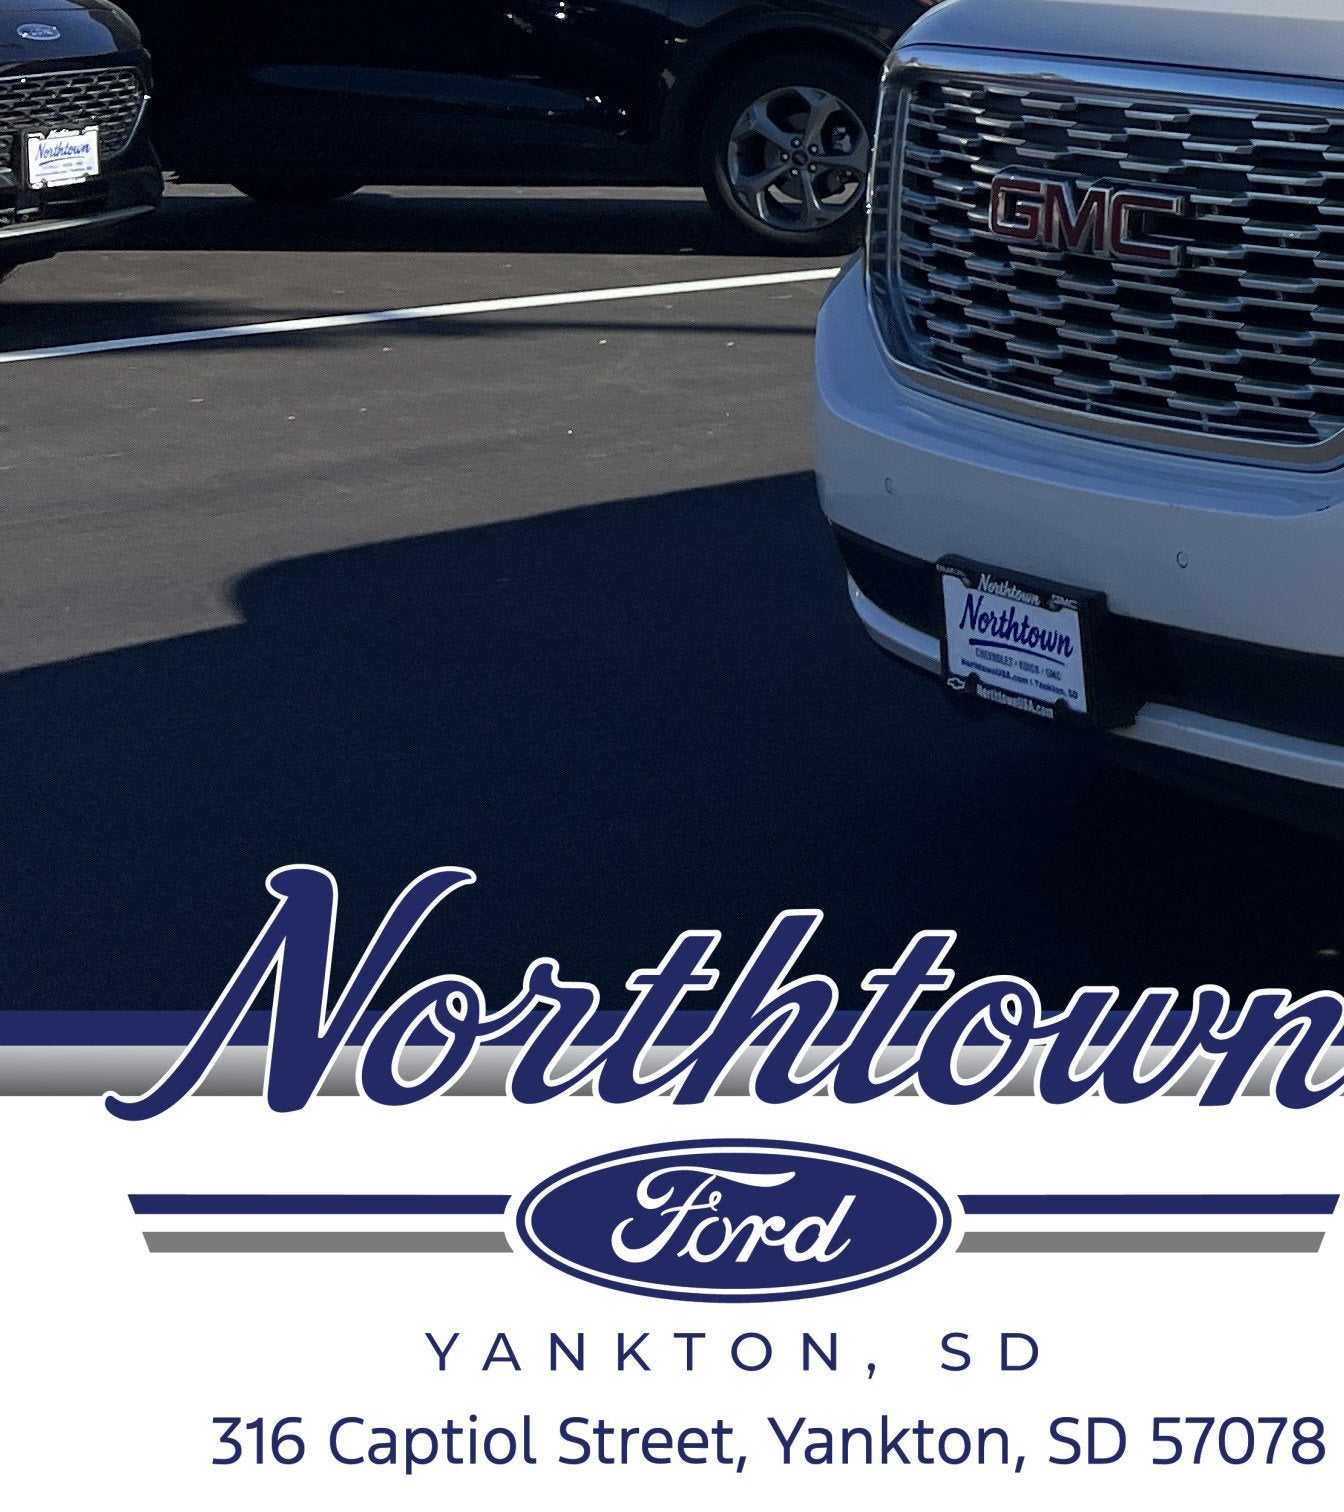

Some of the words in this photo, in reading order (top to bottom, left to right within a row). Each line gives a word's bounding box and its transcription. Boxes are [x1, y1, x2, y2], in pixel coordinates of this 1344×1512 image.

[34, 141, 91, 161] Northtown
[988, 168, 1185, 267] GMC
[978, 573, 1041, 606] Northtown
[959, 593, 1074, 658] Northtown
